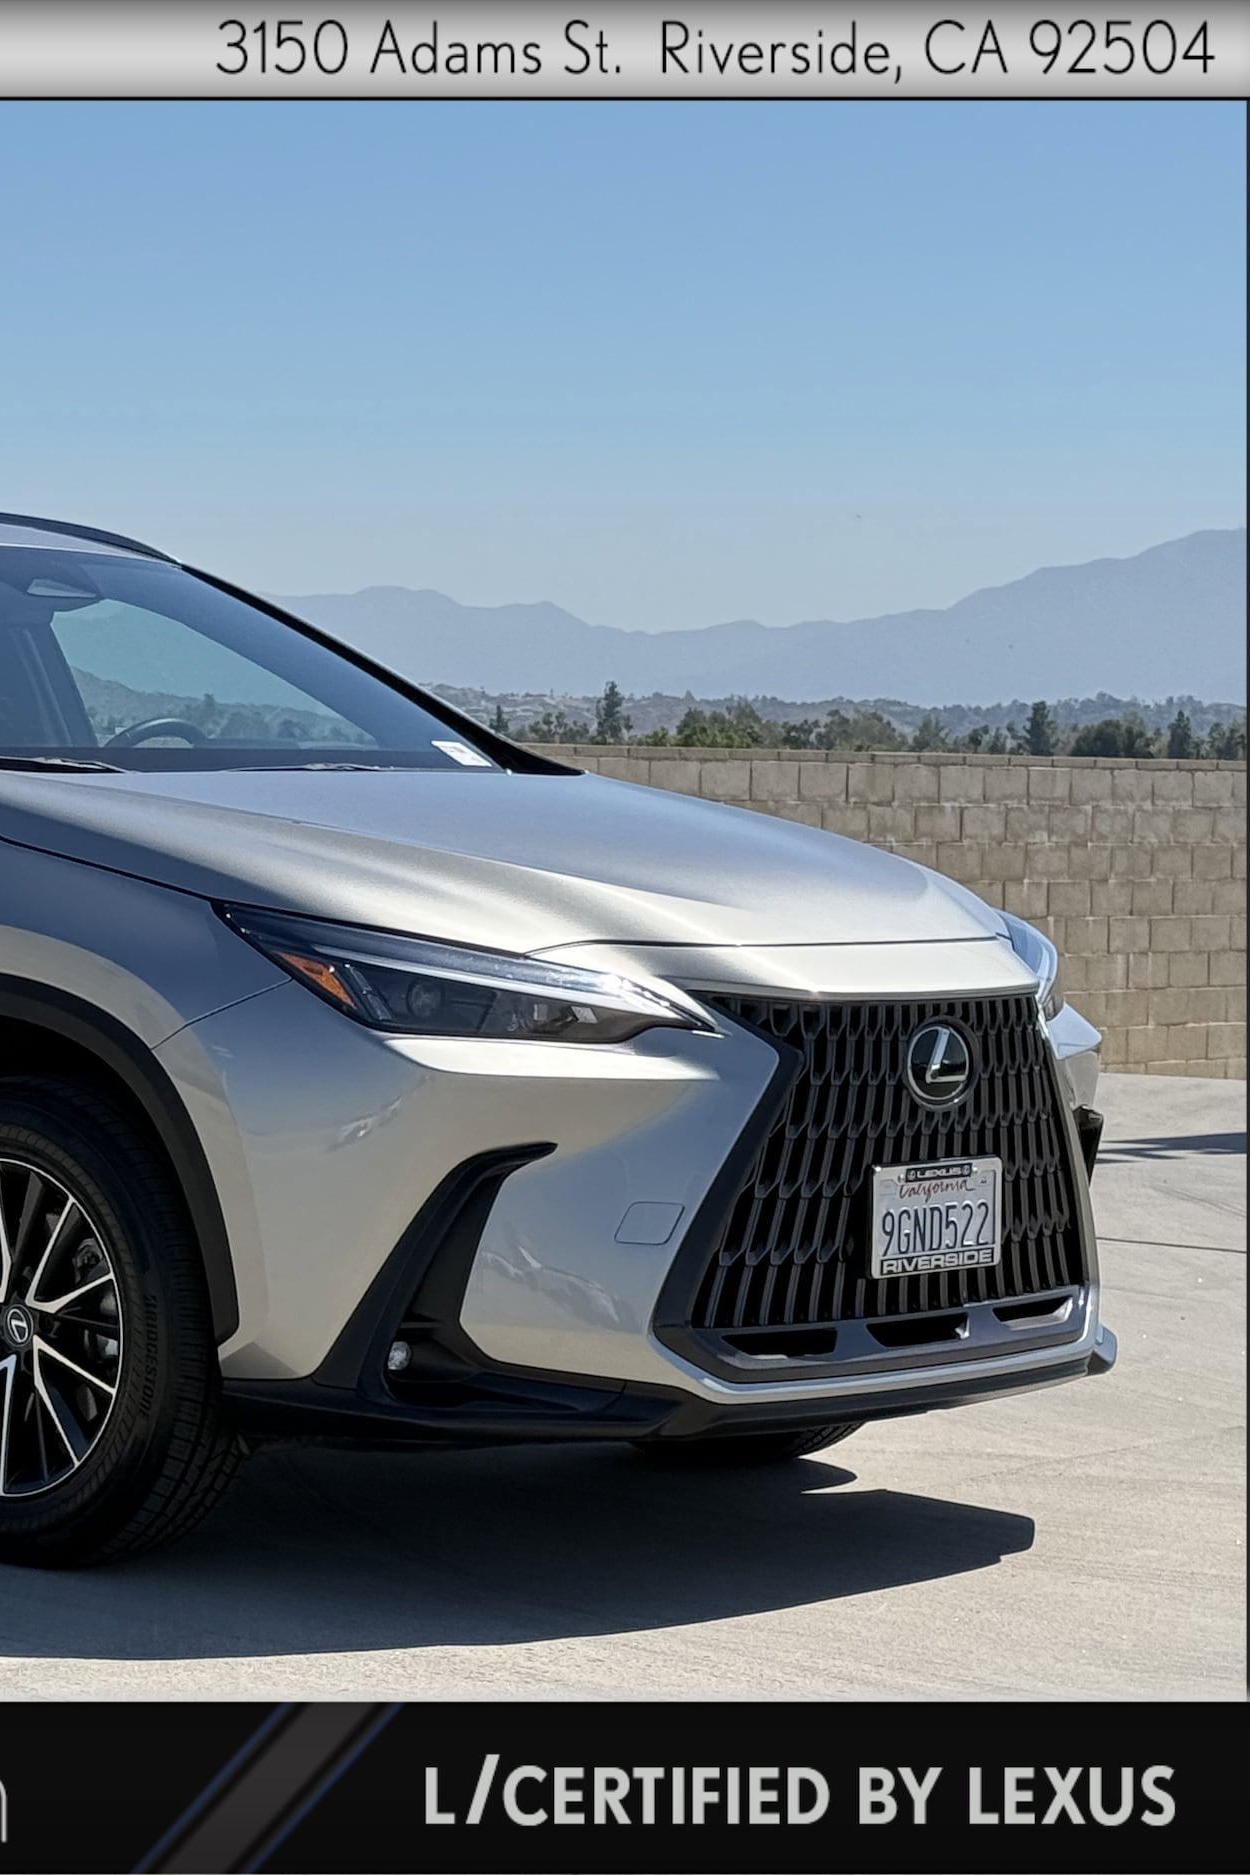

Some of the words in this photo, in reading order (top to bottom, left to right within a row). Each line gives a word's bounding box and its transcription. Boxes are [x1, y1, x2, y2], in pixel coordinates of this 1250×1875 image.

[916, 1166, 963, 1179] LEXUS
[899, 1178, 976, 1203] California
[881, 1200, 990, 1258] 9GND522
[882, 1249, 994, 1275] RIVERSIDE
